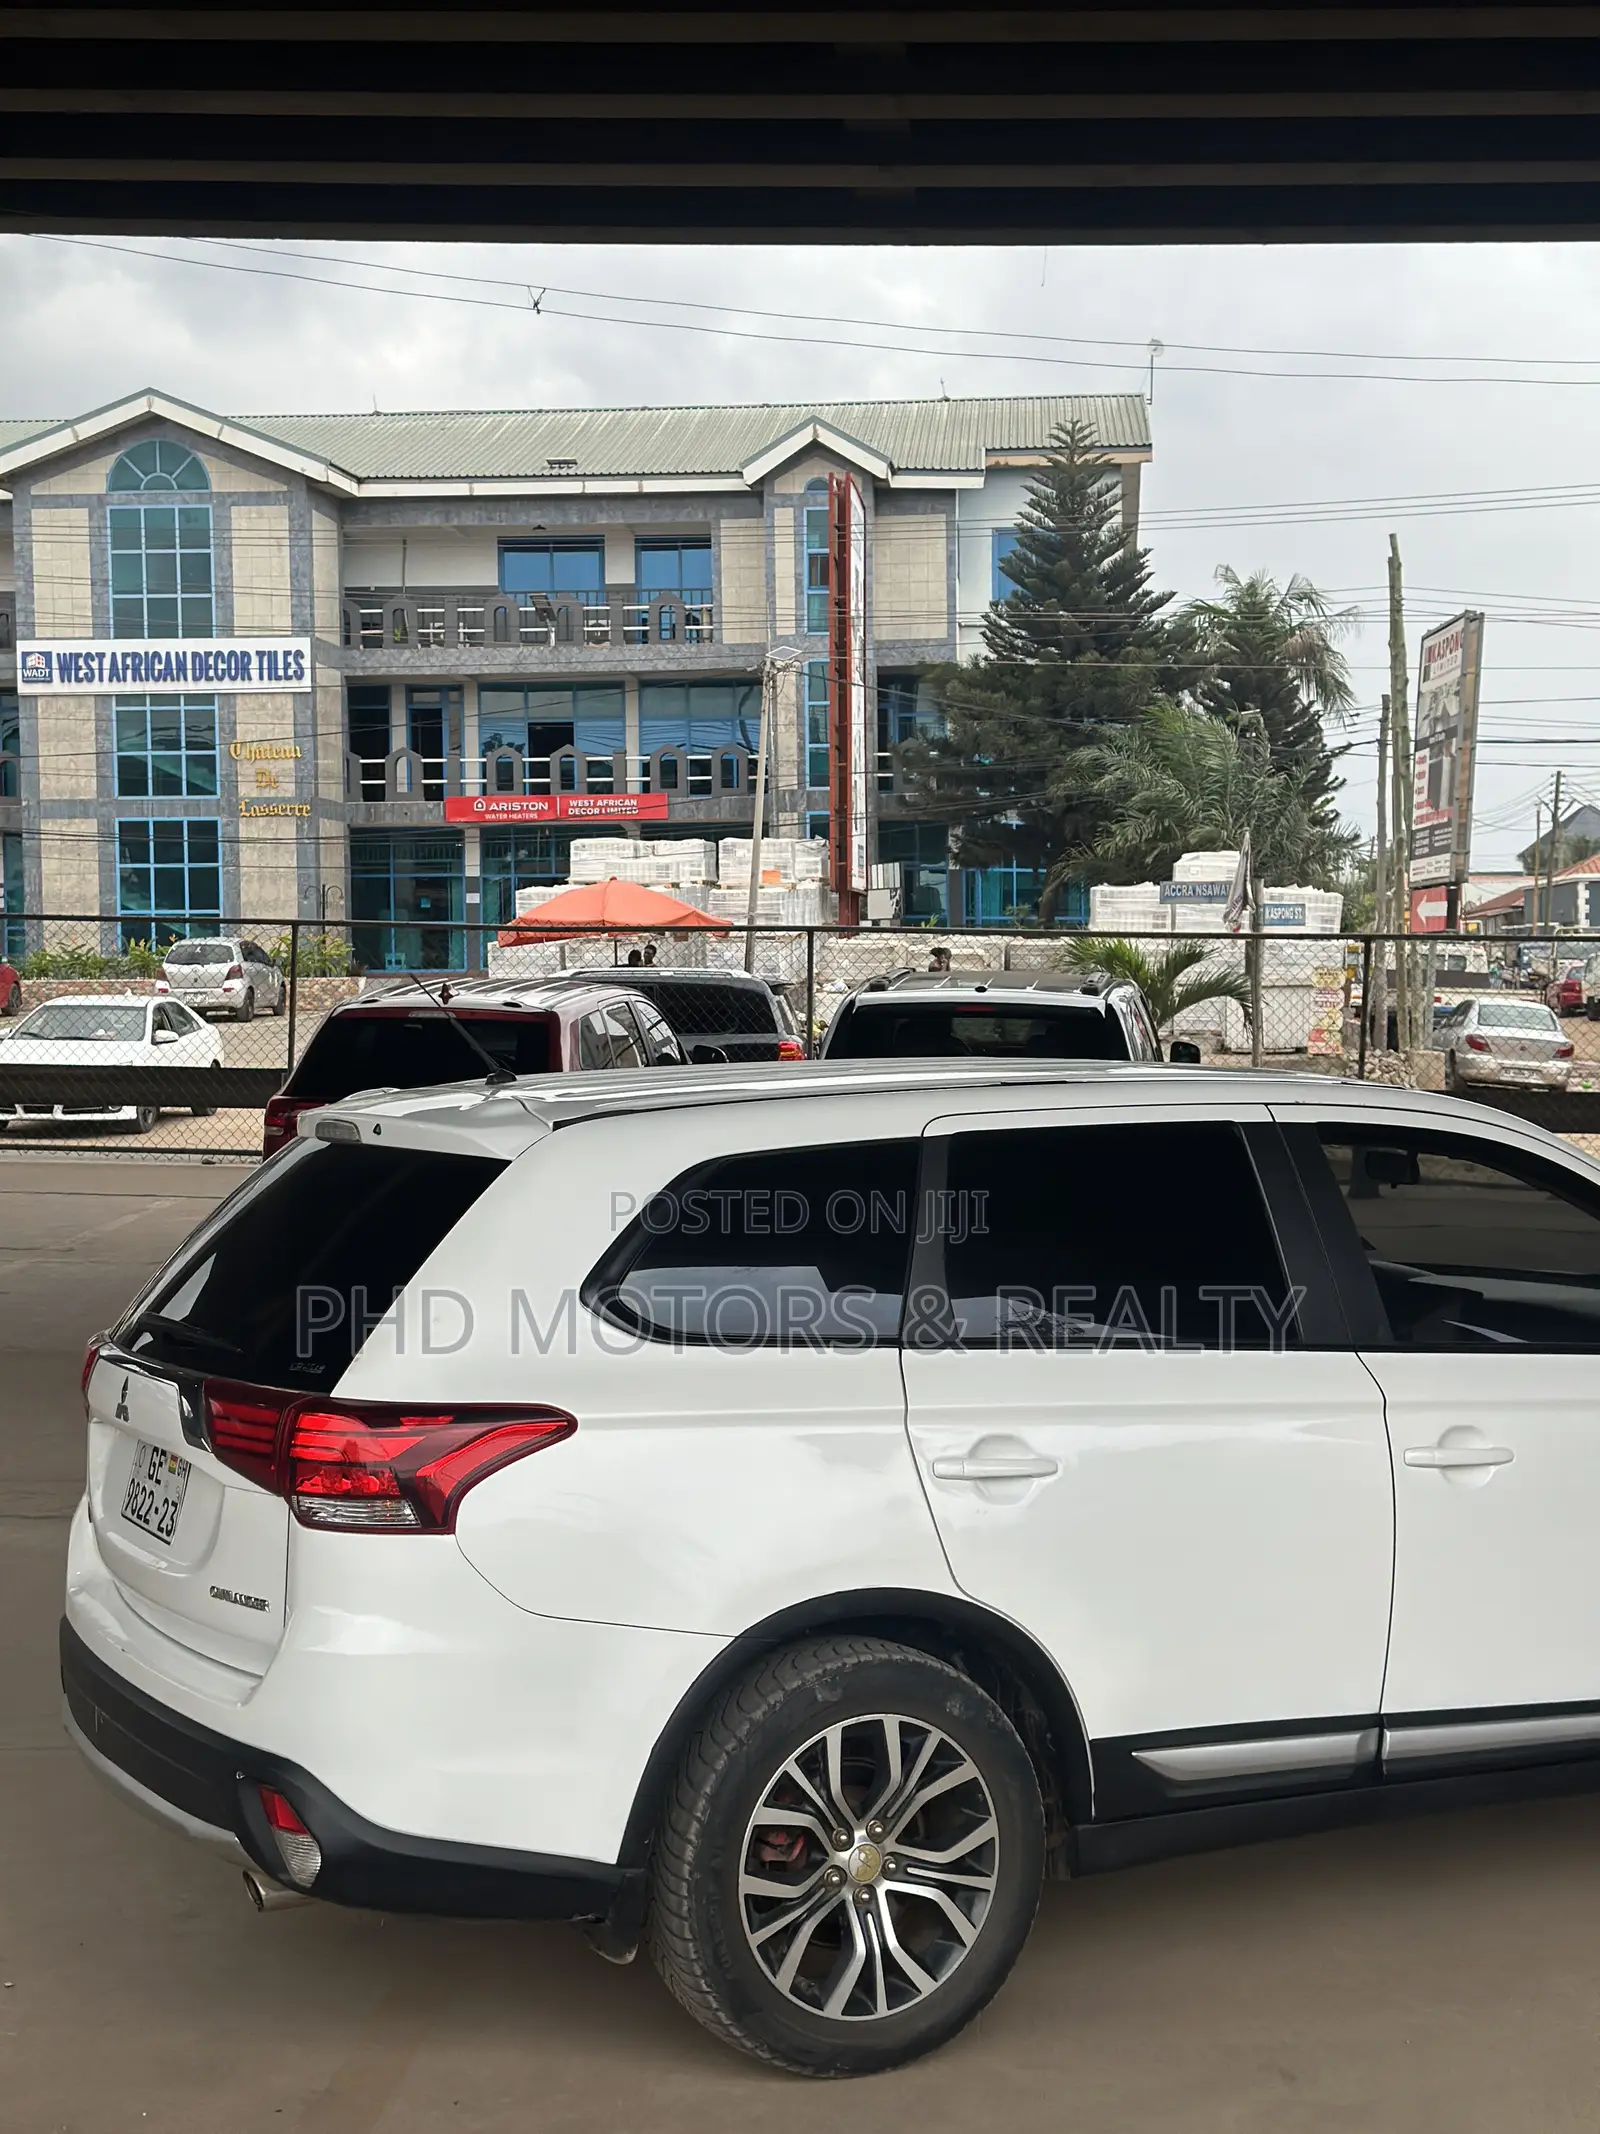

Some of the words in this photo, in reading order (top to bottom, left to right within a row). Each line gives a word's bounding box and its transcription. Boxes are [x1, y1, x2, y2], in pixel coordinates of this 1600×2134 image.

[56, 652, 106, 683] WEST
[108, 651, 188, 682] AFRICAN
[191, 650, 252, 682] DECOR
[255, 649, 305, 681] TILES
[23, 668, 51, 678] WADT
[239, 799, 311, 816] Lasserre
[488, 802, 549, 811] ARISTON
[597, 799, 637, 807] AFRICAN
[508, 812, 539, 820] HEATERS
[601, 807, 639, 815] LIMITED
[1164, 884, 1194, 897] ACCRA
[147, 1446, 168, 1485] GE
[124, 1478, 179, 1537] 9822-23
